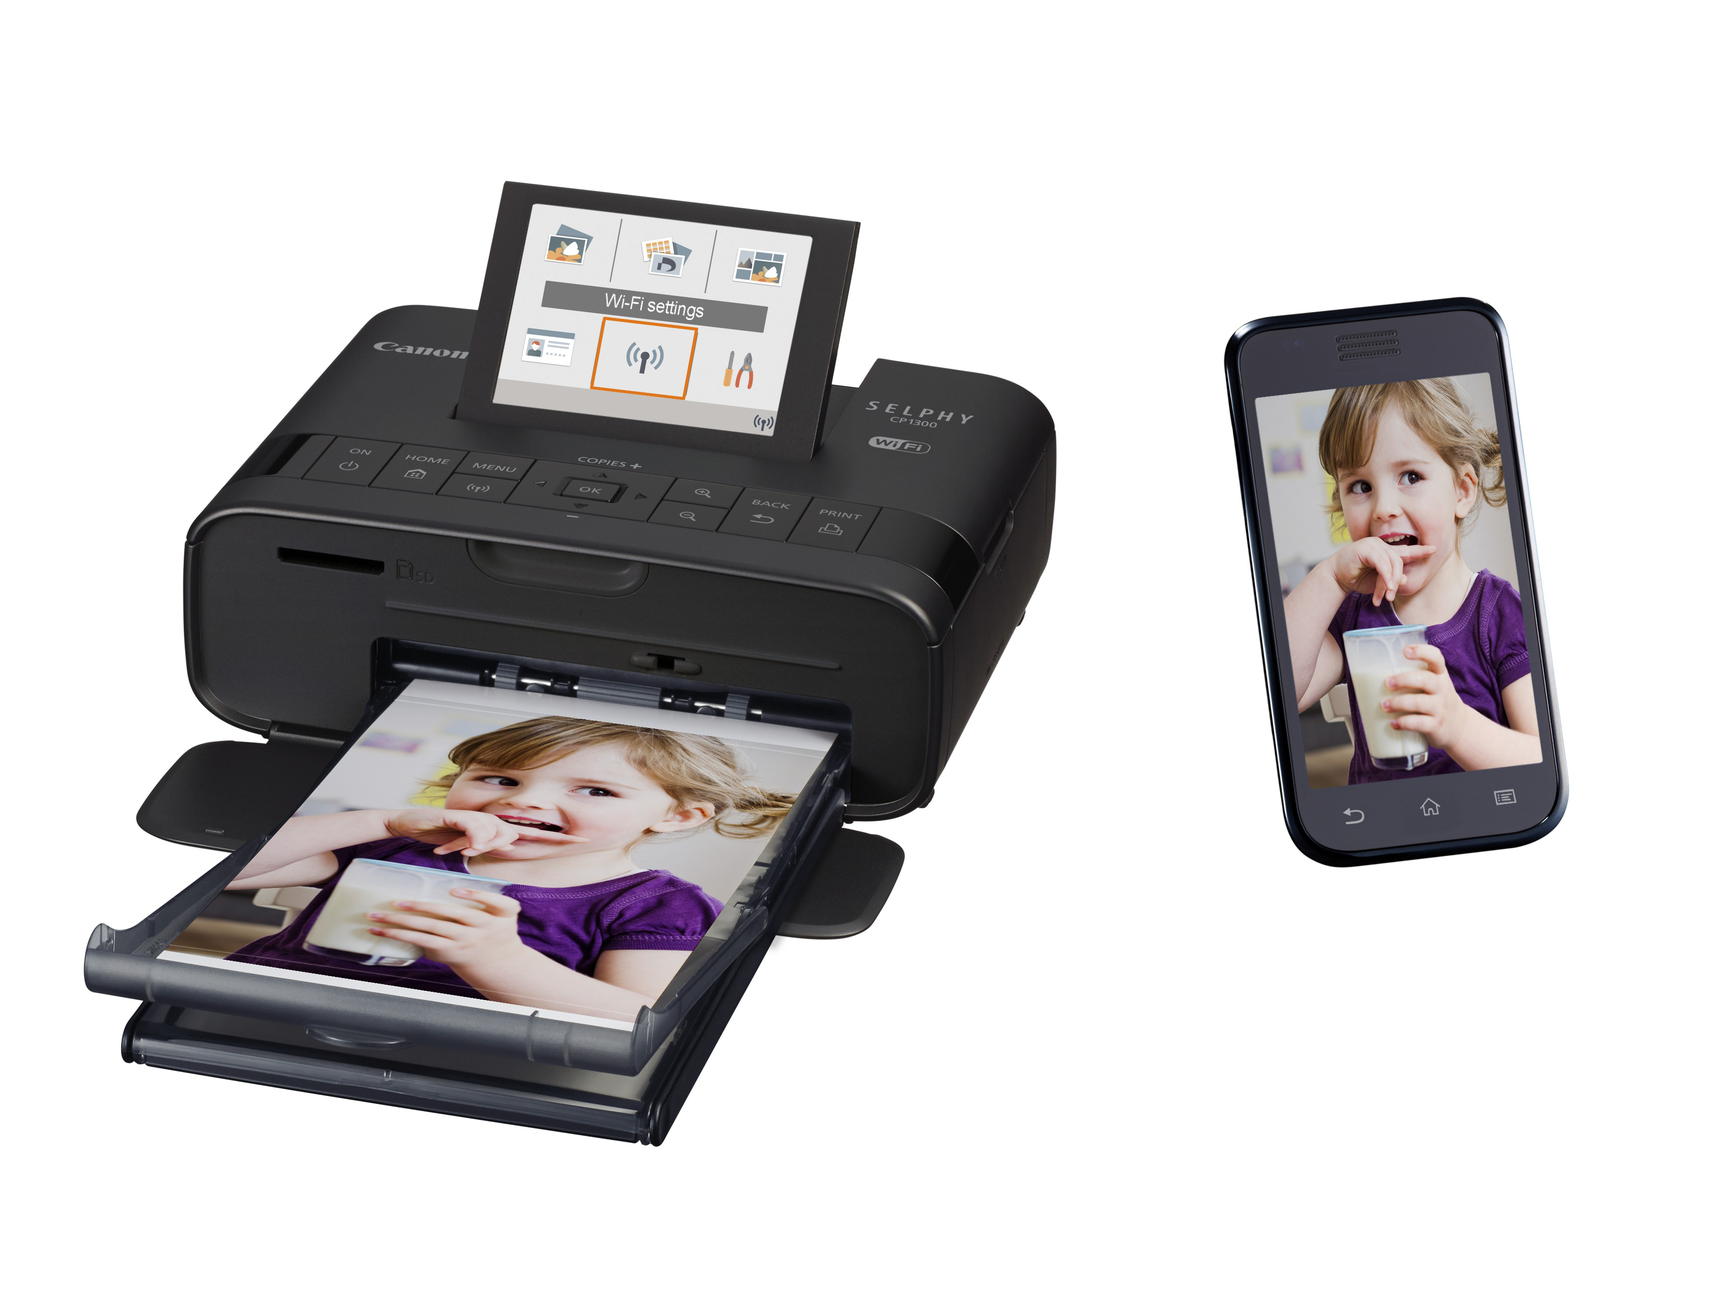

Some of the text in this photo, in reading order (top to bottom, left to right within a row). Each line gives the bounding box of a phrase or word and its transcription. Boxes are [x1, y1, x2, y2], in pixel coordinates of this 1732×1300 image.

[605, 292, 705, 321] Wi-Fi settings
[373, 341, 470, 360] Canon
[865, 400, 975, 425] SELPHY
[889, 416, 938, 428] CP1300
[349, 447, 372, 456] ON
[404, 453, 451, 465] HOME
[577, 456, 627, 468] COPIES
[472, 462, 518, 473] MENU
[579, 486, 603, 495] OK
[751, 499, 792, 510] BACK
[818, 508, 863, 520] PRINT
[415, 570, 436, 585] SD
